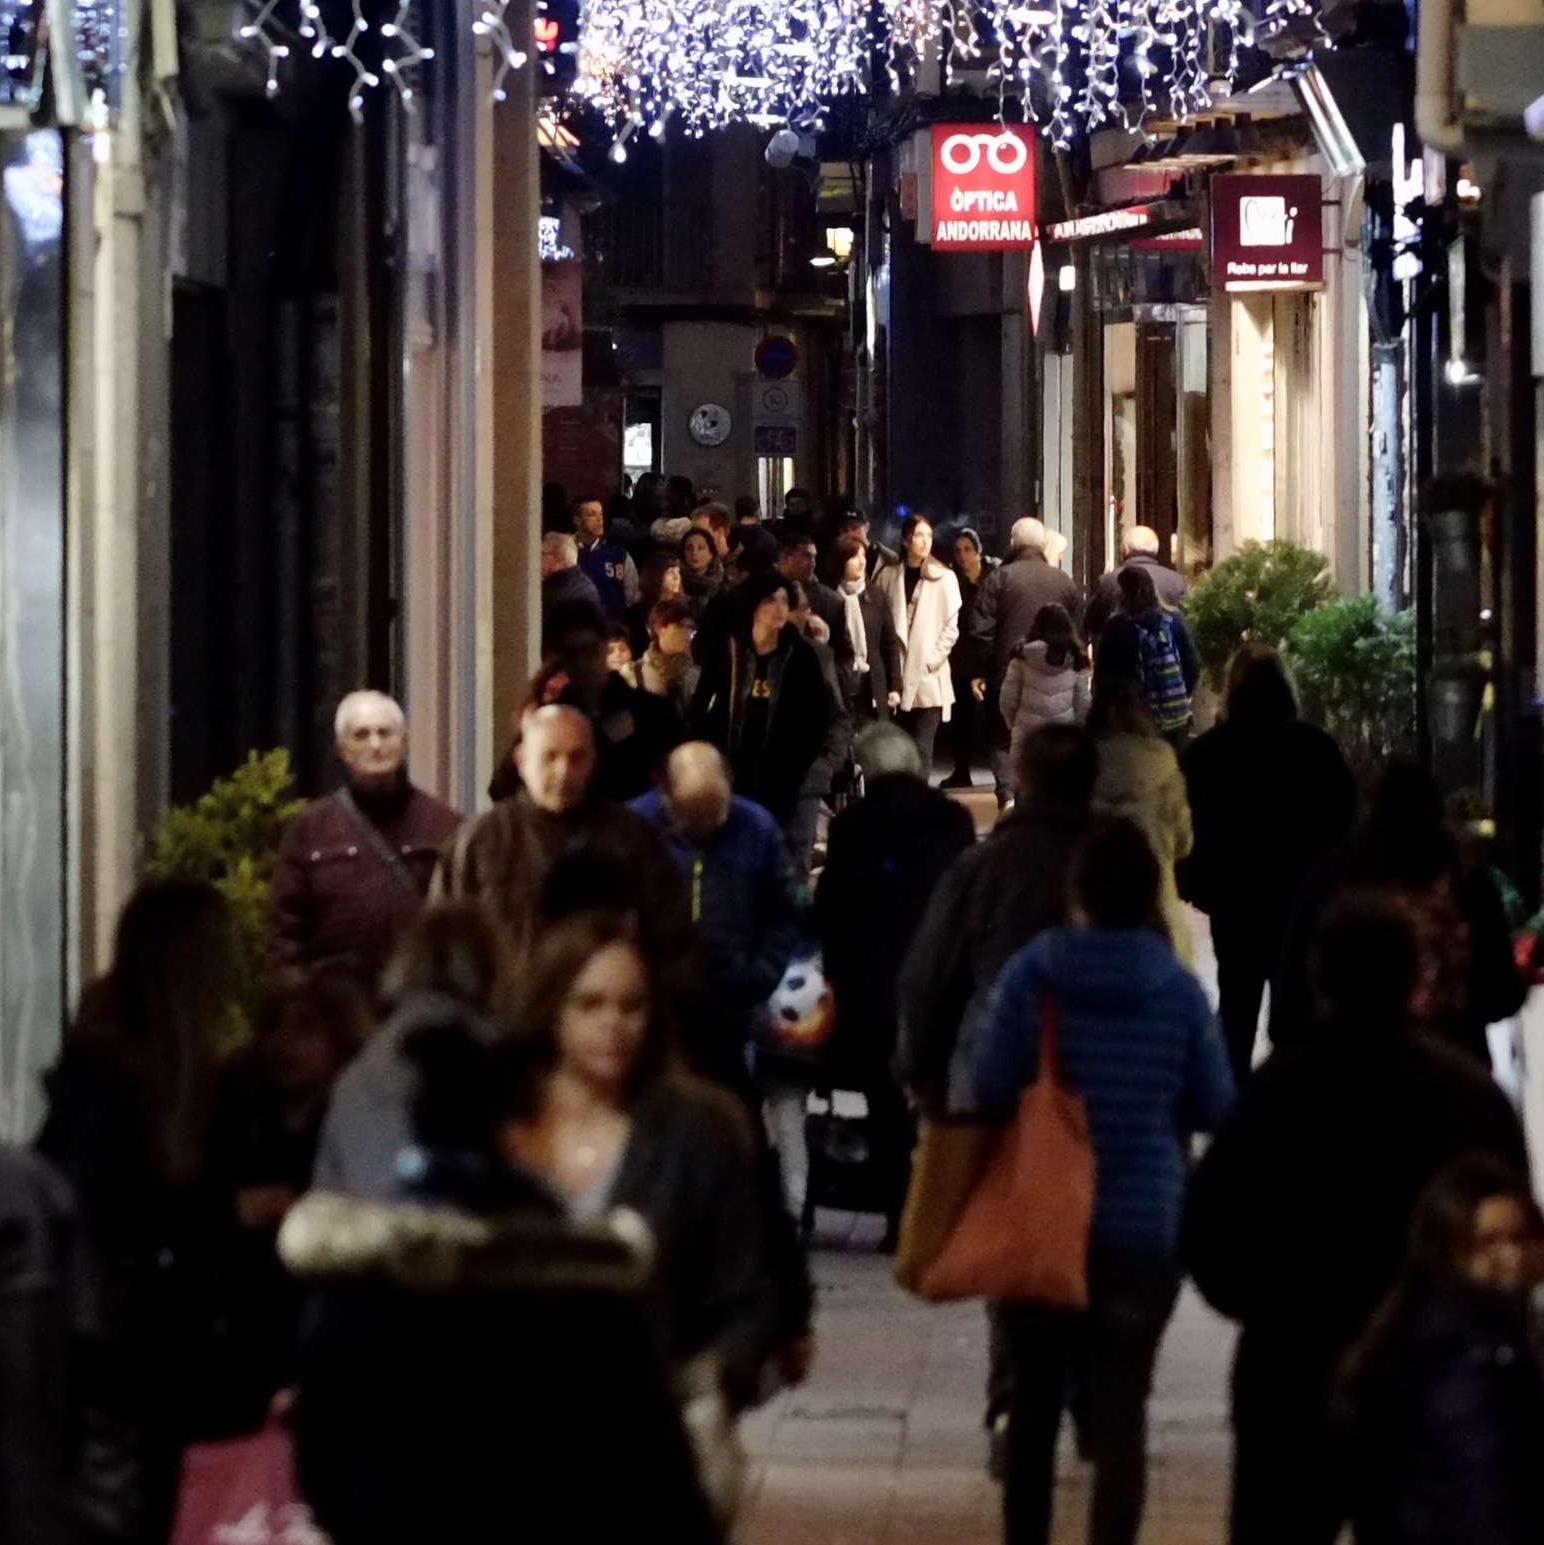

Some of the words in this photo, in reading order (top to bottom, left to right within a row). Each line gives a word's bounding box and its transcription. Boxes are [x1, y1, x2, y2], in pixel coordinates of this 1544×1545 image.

[950, 186, 1018, 212] ÒPTICA
[936, 220, 1032, 241] ANDORRANA
[604, 562, 624, 581] 58
